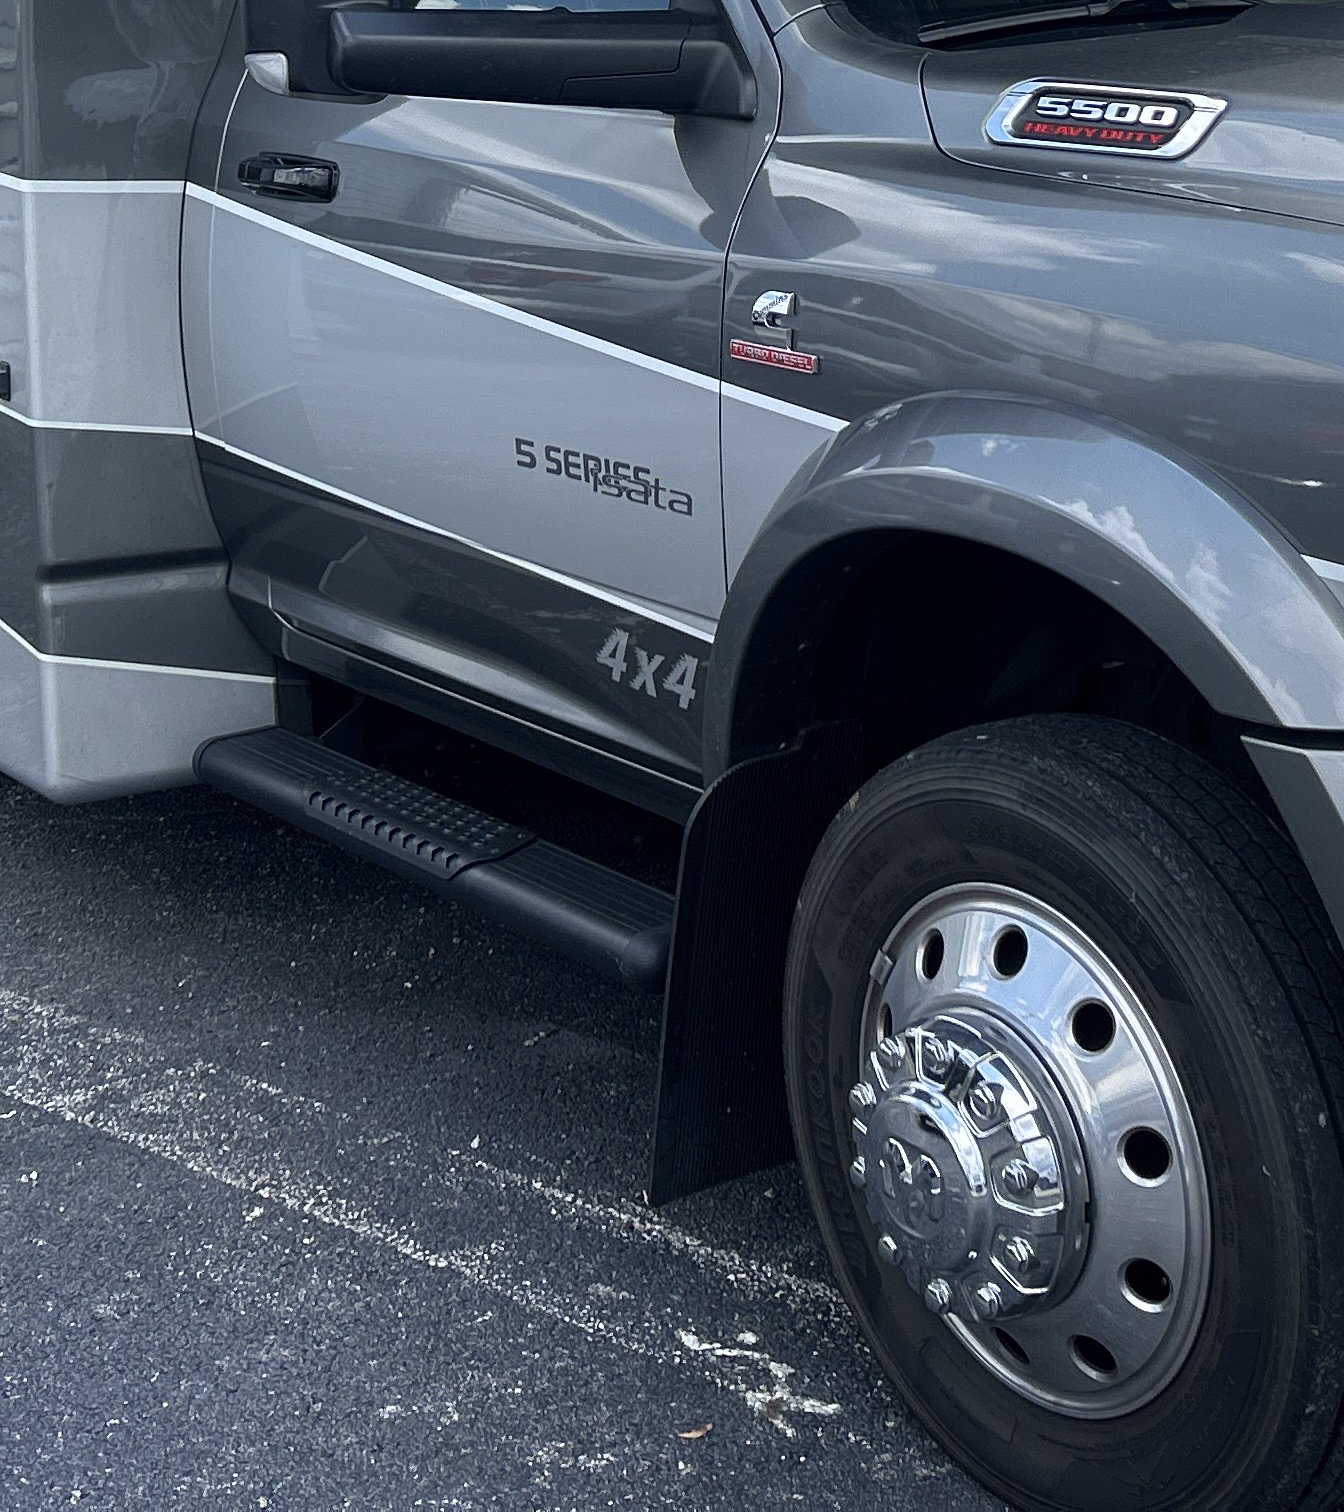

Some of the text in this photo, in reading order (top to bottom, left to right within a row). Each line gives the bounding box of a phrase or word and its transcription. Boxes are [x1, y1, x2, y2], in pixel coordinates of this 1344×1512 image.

[1035, 95, 1178, 128] 5500
[1023, 121, 1166, 144] HEAVY DUTY
[514, 437, 652, 500] 5 SERIES
